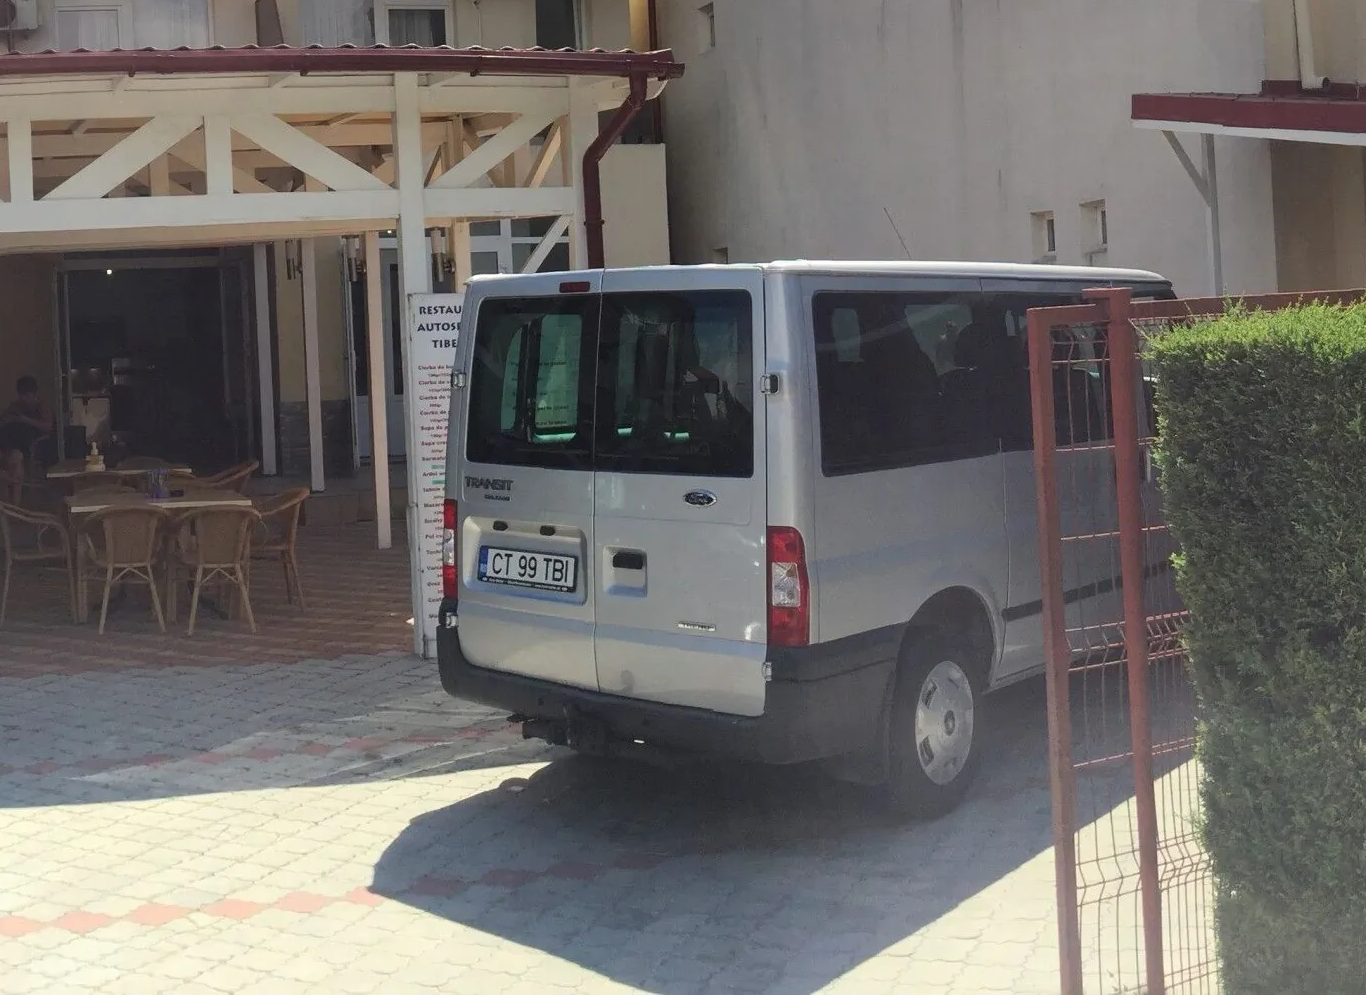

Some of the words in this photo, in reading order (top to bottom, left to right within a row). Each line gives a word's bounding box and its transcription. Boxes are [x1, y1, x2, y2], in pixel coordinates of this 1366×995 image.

[419, 305, 462, 315] RESTAU
[431, 339, 457, 348] TIBE
[465, 476, 513, 491] TRANSIT
[492, 552, 513, 576] CT
[518, 555, 537, 578] 99
[543, 558, 569, 583] TBI
